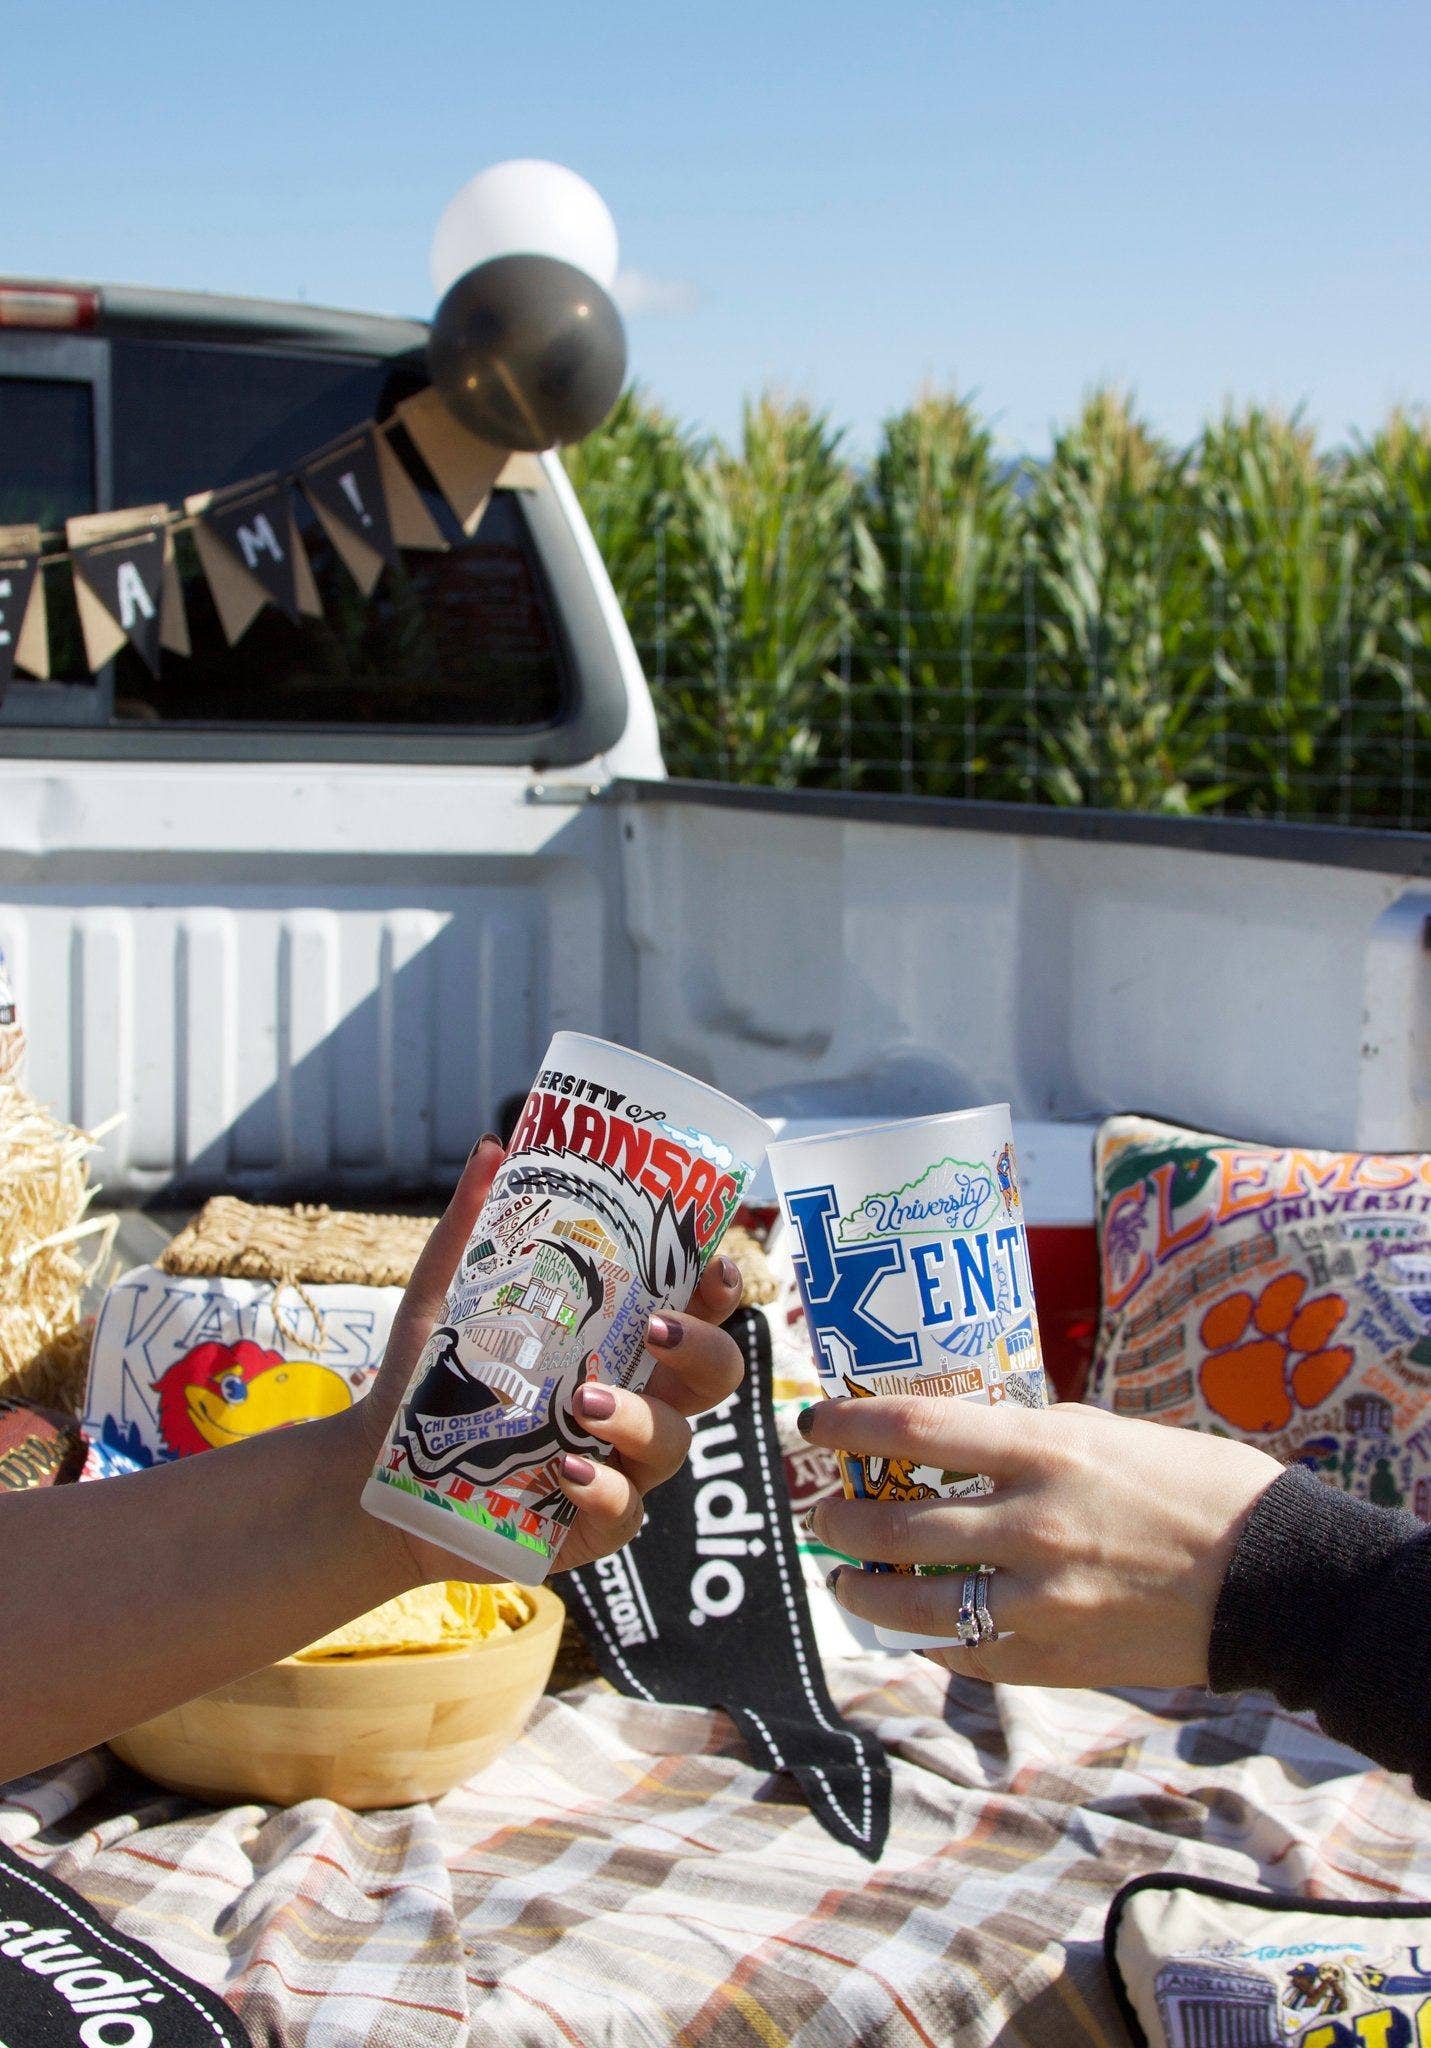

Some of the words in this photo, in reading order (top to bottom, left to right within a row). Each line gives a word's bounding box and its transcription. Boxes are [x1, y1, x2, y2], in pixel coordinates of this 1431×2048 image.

[625, 1104, 667, 1124] of
[503, 1091, 739, 1248] RKANSAS
[864, 1172, 992, 1232] University
[946, 1213, 963, 1230] of
[531, 1262, 563, 1285] UNION
[535, 1244, 585, 1300] ARKANSAS
[597, 1259, 630, 1284] FIELD
[597, 1275, 644, 1362] FULBRIGHT
[604, 1303, 645, 1375] PEACE
[872, 1374, 909, 1397] MAIN
[911, 1368, 981, 1398] BUILDING
[424, 1420, 445, 1434] CHI
[448, 1407, 506, 1430] OMEGA
[430, 1425, 490, 1452] GREEK
